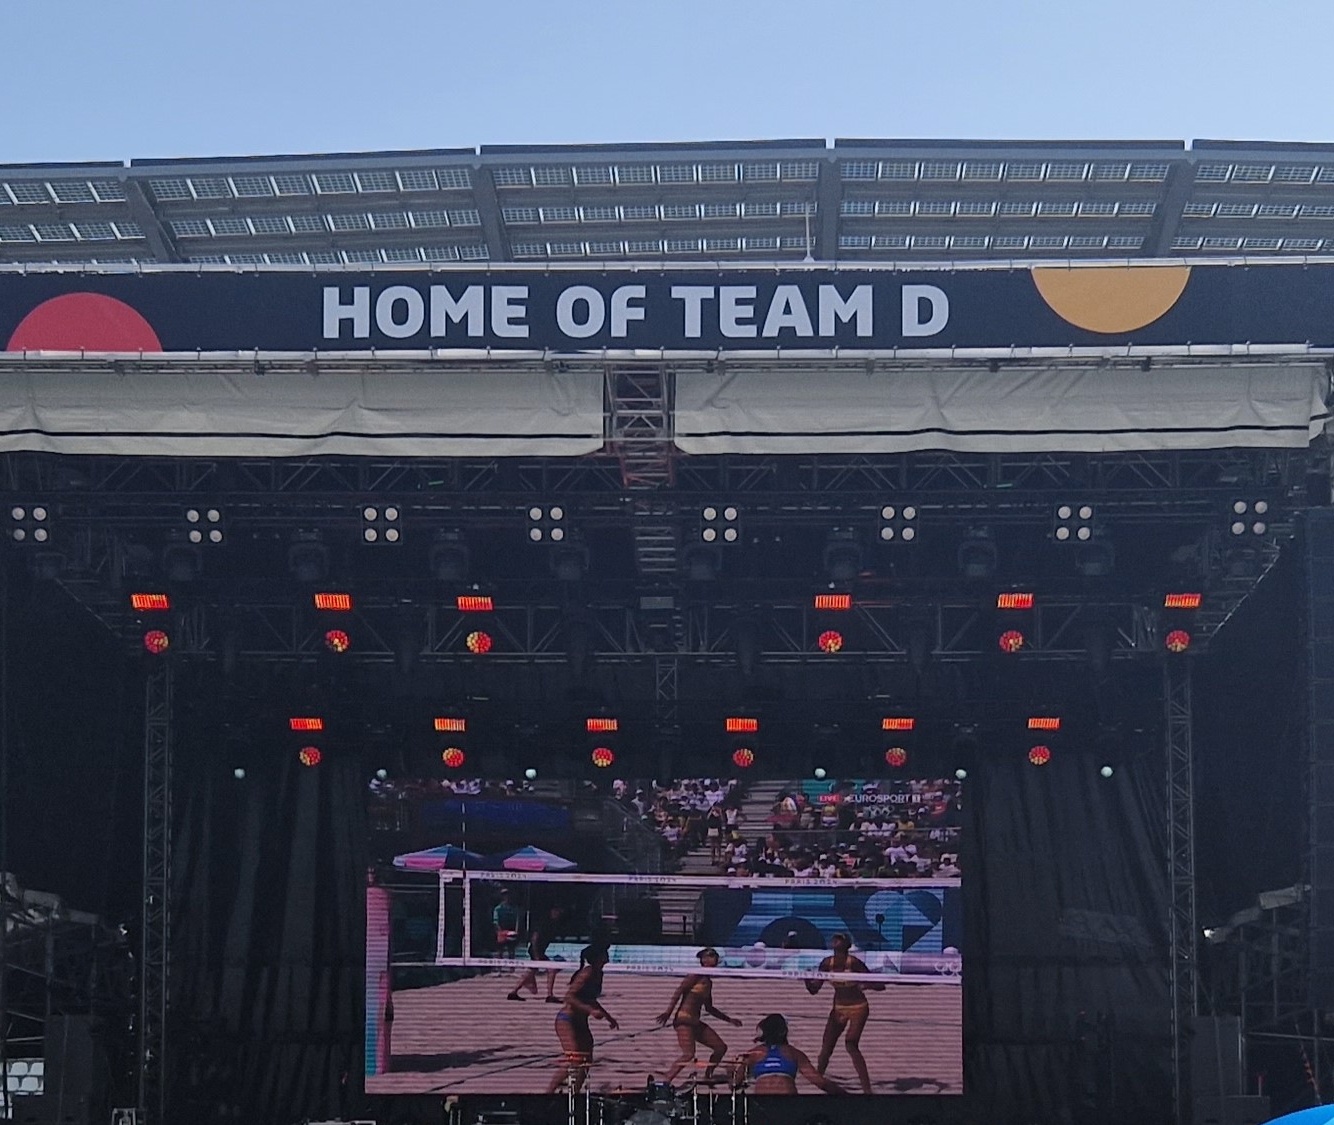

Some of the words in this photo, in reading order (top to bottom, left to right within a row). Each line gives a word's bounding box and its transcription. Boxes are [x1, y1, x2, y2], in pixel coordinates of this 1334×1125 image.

[322, 284, 529, 338] HOME
[556, 284, 646, 338] OF
[671, 284, 874, 337] TEAM
[902, 284, 950, 337] D
[849, 793, 910, 804] EUROSPORT
